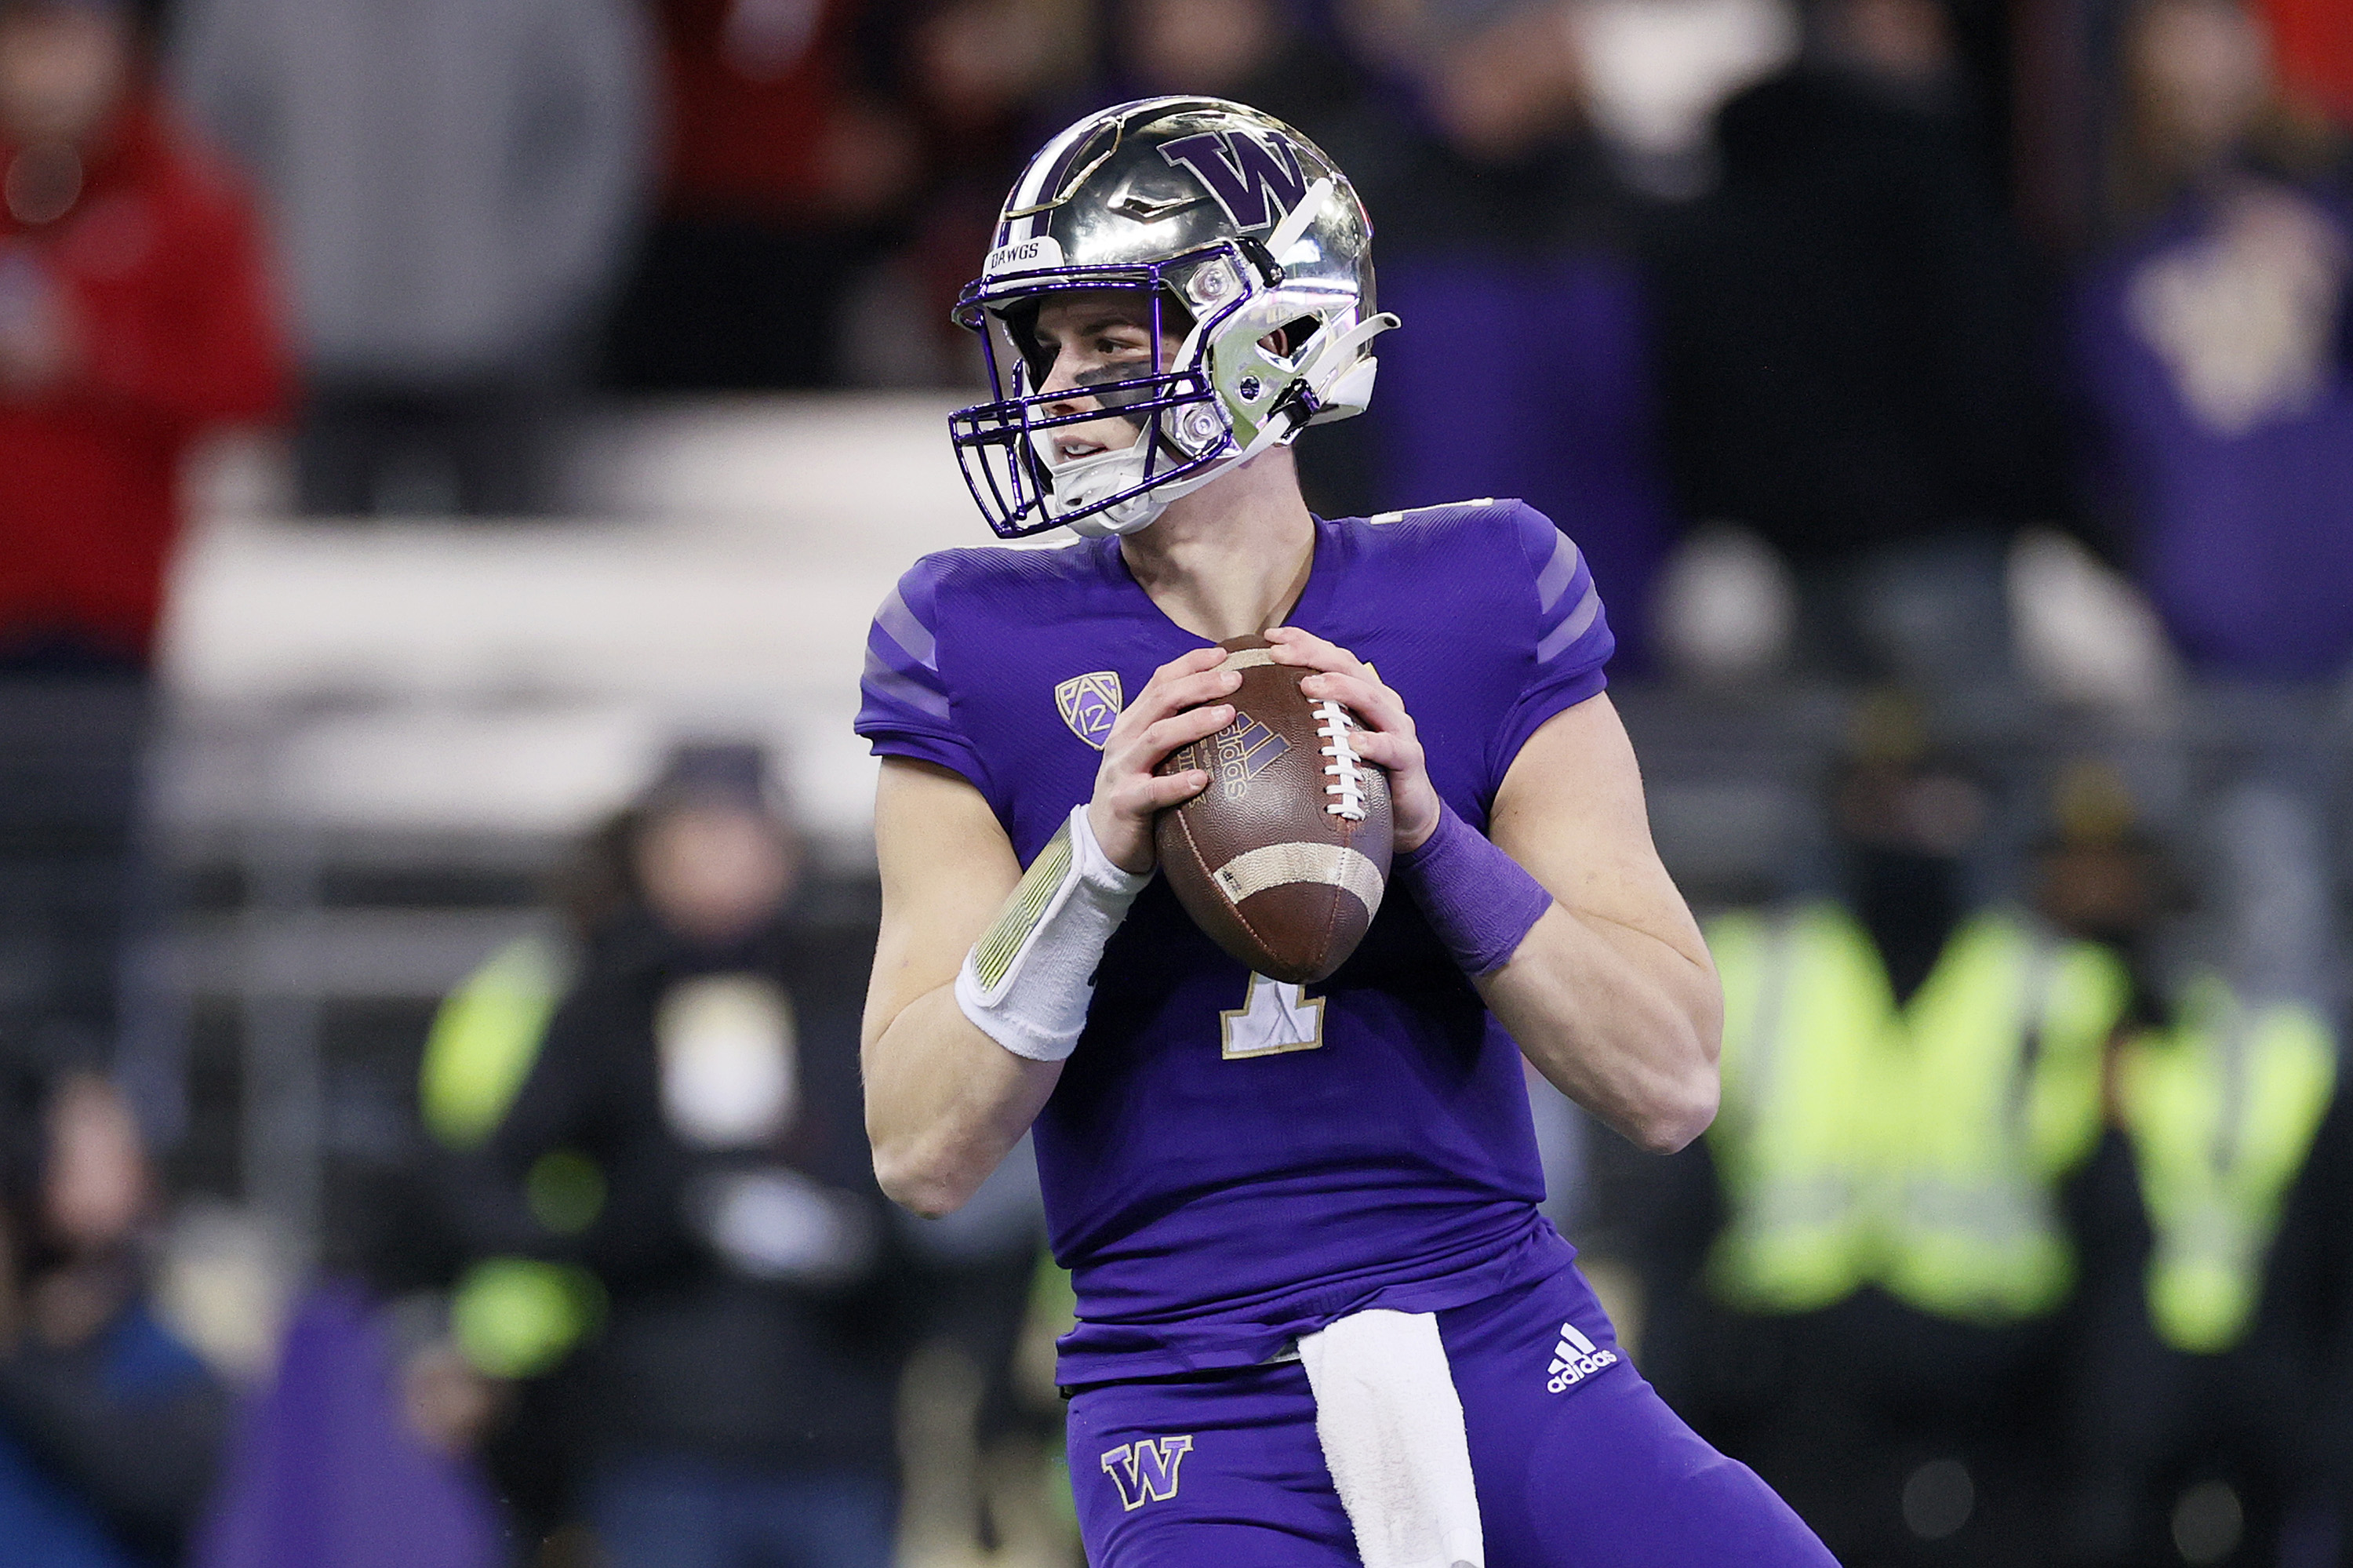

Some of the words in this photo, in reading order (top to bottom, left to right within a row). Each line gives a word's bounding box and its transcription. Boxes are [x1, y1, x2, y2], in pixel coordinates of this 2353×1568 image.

[1156, 128, 1310, 234] W
[991, 242, 1039, 270] DAWGS
[1059, 676, 1118, 726] PAC
[1078, 704, 1112, 736] 12
[1215, 724, 1247, 799] didas
[1547, 1349, 1617, 1393] adidas
[1100, 1435, 1194, 1512] W
